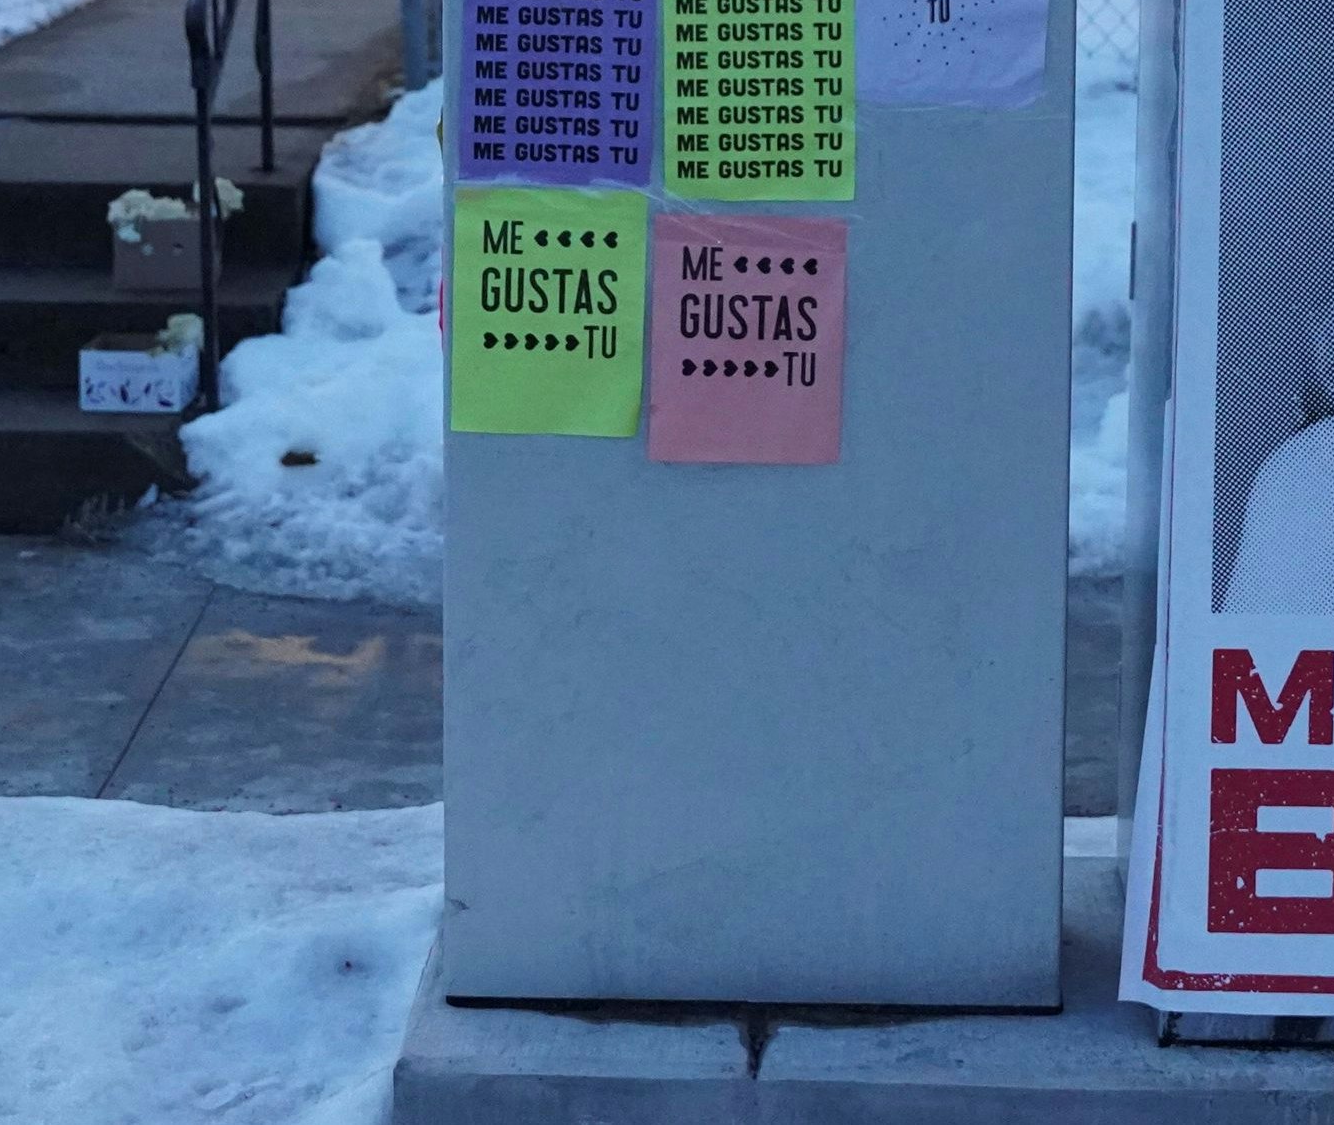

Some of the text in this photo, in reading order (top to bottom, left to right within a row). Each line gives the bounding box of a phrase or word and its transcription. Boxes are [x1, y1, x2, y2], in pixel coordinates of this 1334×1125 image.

[476, 5, 643, 29] ME GUSTAS TU
[675, 22, 842, 43] ME GUSTAS TU
[475, 33, 642, 57] ME GUSTAS TU
[676, 49, 842, 70] ME GUSTAS TU
[475, 60, 641, 84] ME GUSTAS TU
[474, 87, 640, 112] ME GUSTAS TU
[676, 77, 843, 98] ME GUSTAS TU
[676, 104, 843, 125] ME GUSTAS TU
[473, 115, 639, 139] ME GUSTAS TU
[473, 141, 639, 166] ME GUSTAS TU
[676, 132, 843, 153] ME GUSTAS TU
[677, 159, 843, 180] ME GUSTAS TU
[483, 219, 524, 255] ME
[682, 245, 724, 282] ME
[481, 266, 618, 315] GUSTAS
[680, 293, 818, 342] GUSTAS
[583, 325, 617, 360] TU
[782, 351, 816, 387] TU
